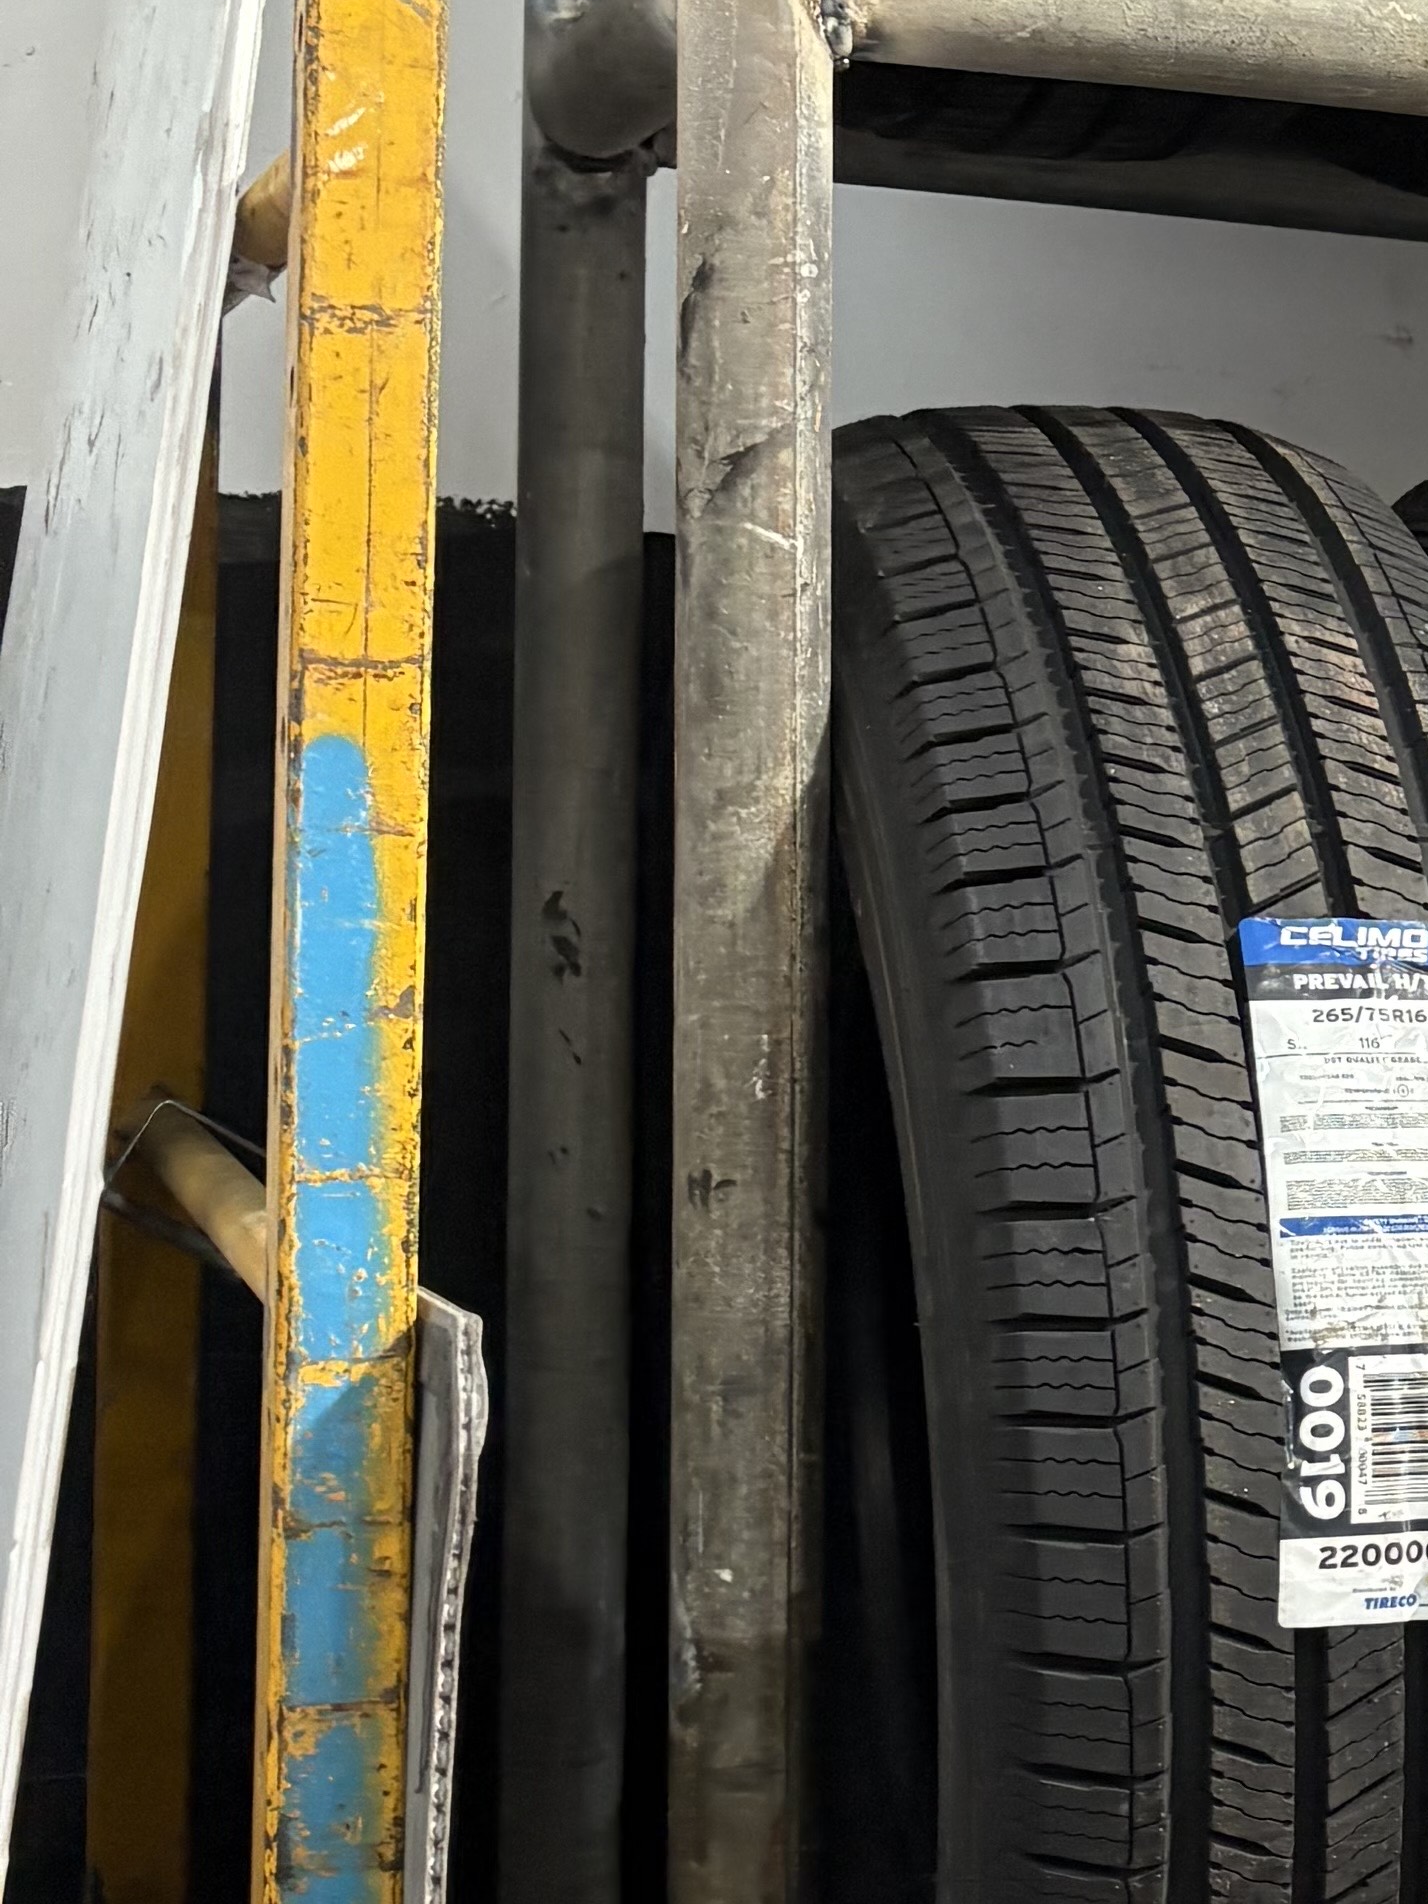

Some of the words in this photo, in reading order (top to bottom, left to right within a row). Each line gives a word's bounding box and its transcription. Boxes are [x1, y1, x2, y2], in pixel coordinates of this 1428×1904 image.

[1280, 925, 1428, 949] CELIMO
[1294, 972, 1389, 992] PREVAIL
[1312, 1007, 1427, 1024] 265/75R16
[1300, 1364, 1346, 1520] 0019
[1364, 1594, 1418, 1611] TIRECO
